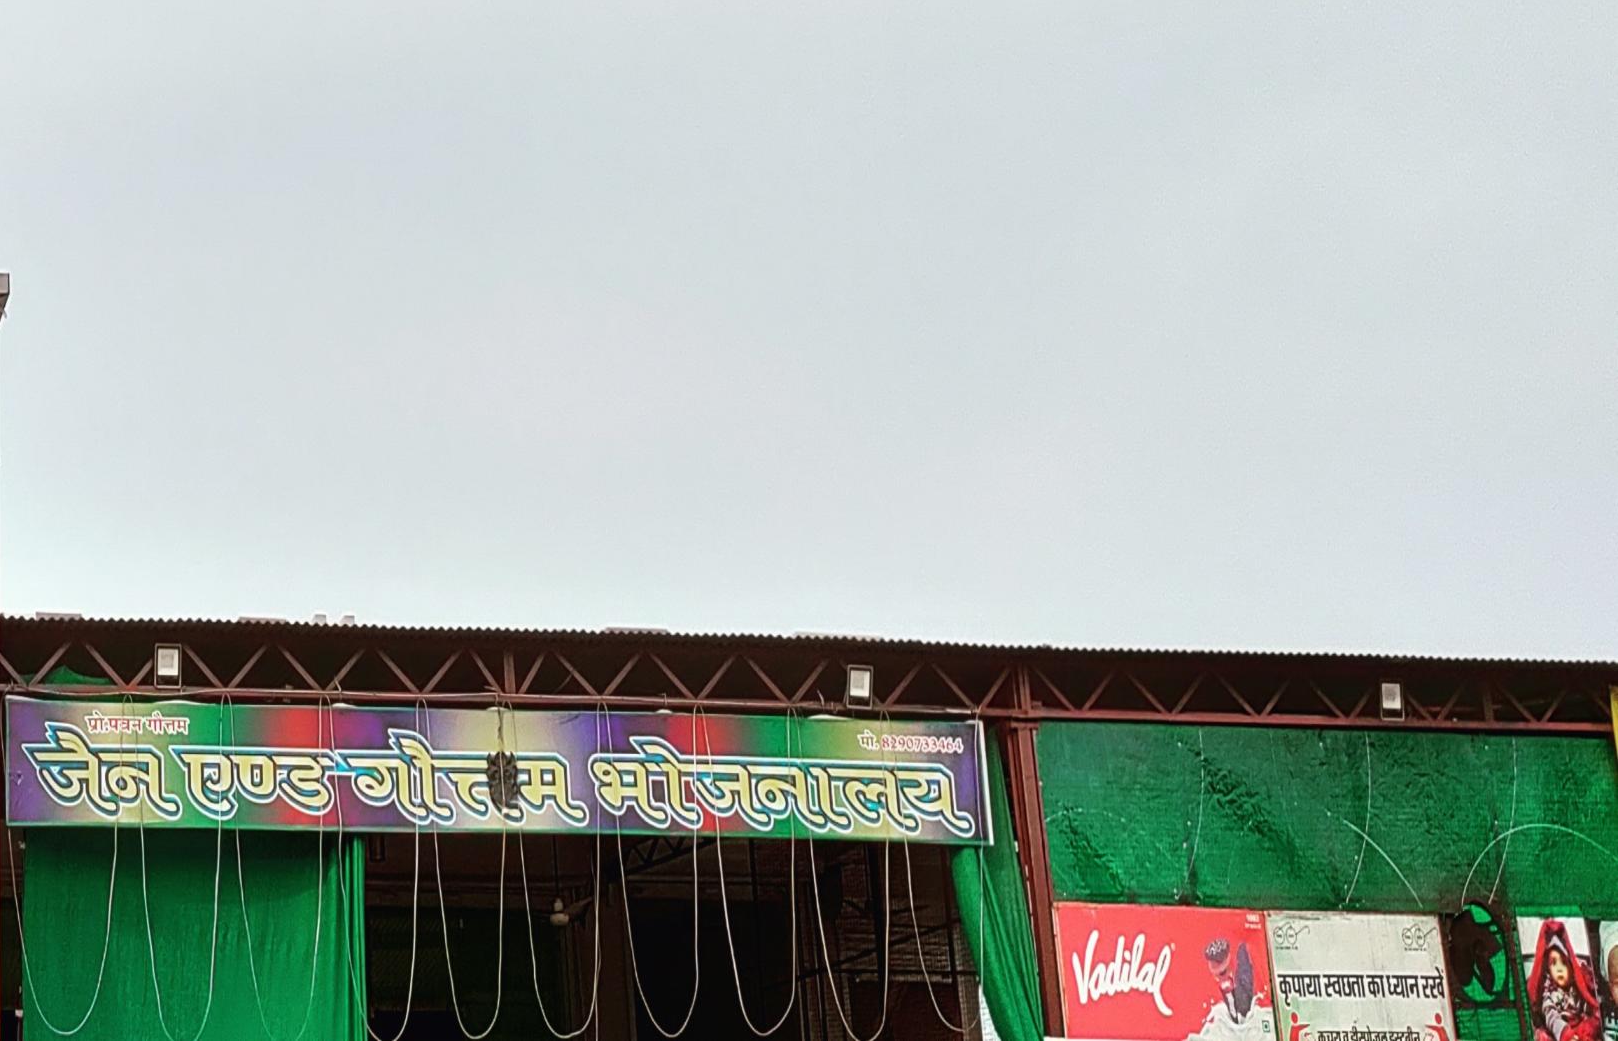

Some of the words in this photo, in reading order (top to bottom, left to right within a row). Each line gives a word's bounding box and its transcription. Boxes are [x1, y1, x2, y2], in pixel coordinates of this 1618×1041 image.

[168, 745, 333, 821] एण्ड
[588, 736, 974, 837] भोजनालय
[1072, 930, 1173, 1016] Vadilal
[1277, 974, 1322, 1006] कृपाया
[1366, 974, 1385, 998] का
[1385, 974, 1420, 998] ध्यान
